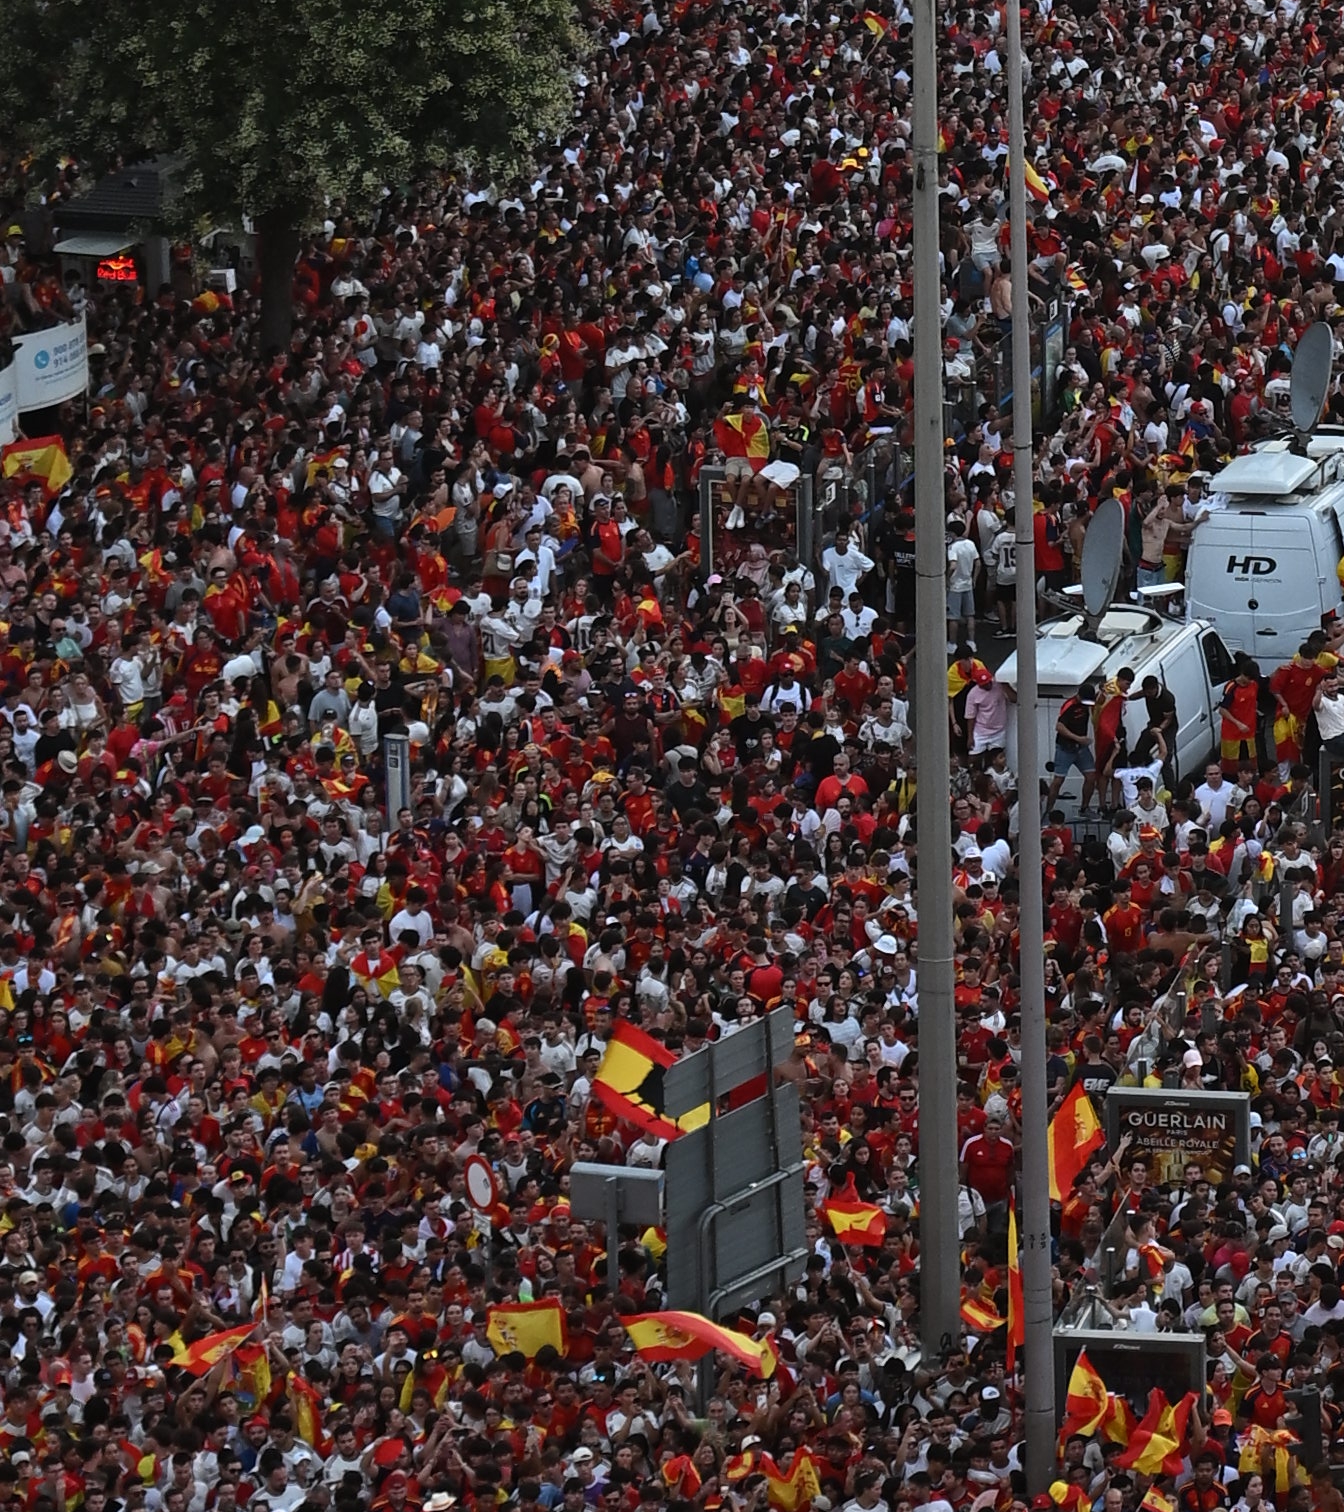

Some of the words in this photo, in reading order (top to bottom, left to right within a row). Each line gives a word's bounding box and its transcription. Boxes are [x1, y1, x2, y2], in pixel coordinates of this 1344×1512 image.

[1226, 555, 1277, 575] HD
[1127, 1112, 1226, 1130] GUERLAIN
[1135, 1136, 1178, 1147] ABEILLE
[1179, 1139, 1220, 1150] ROYALE
